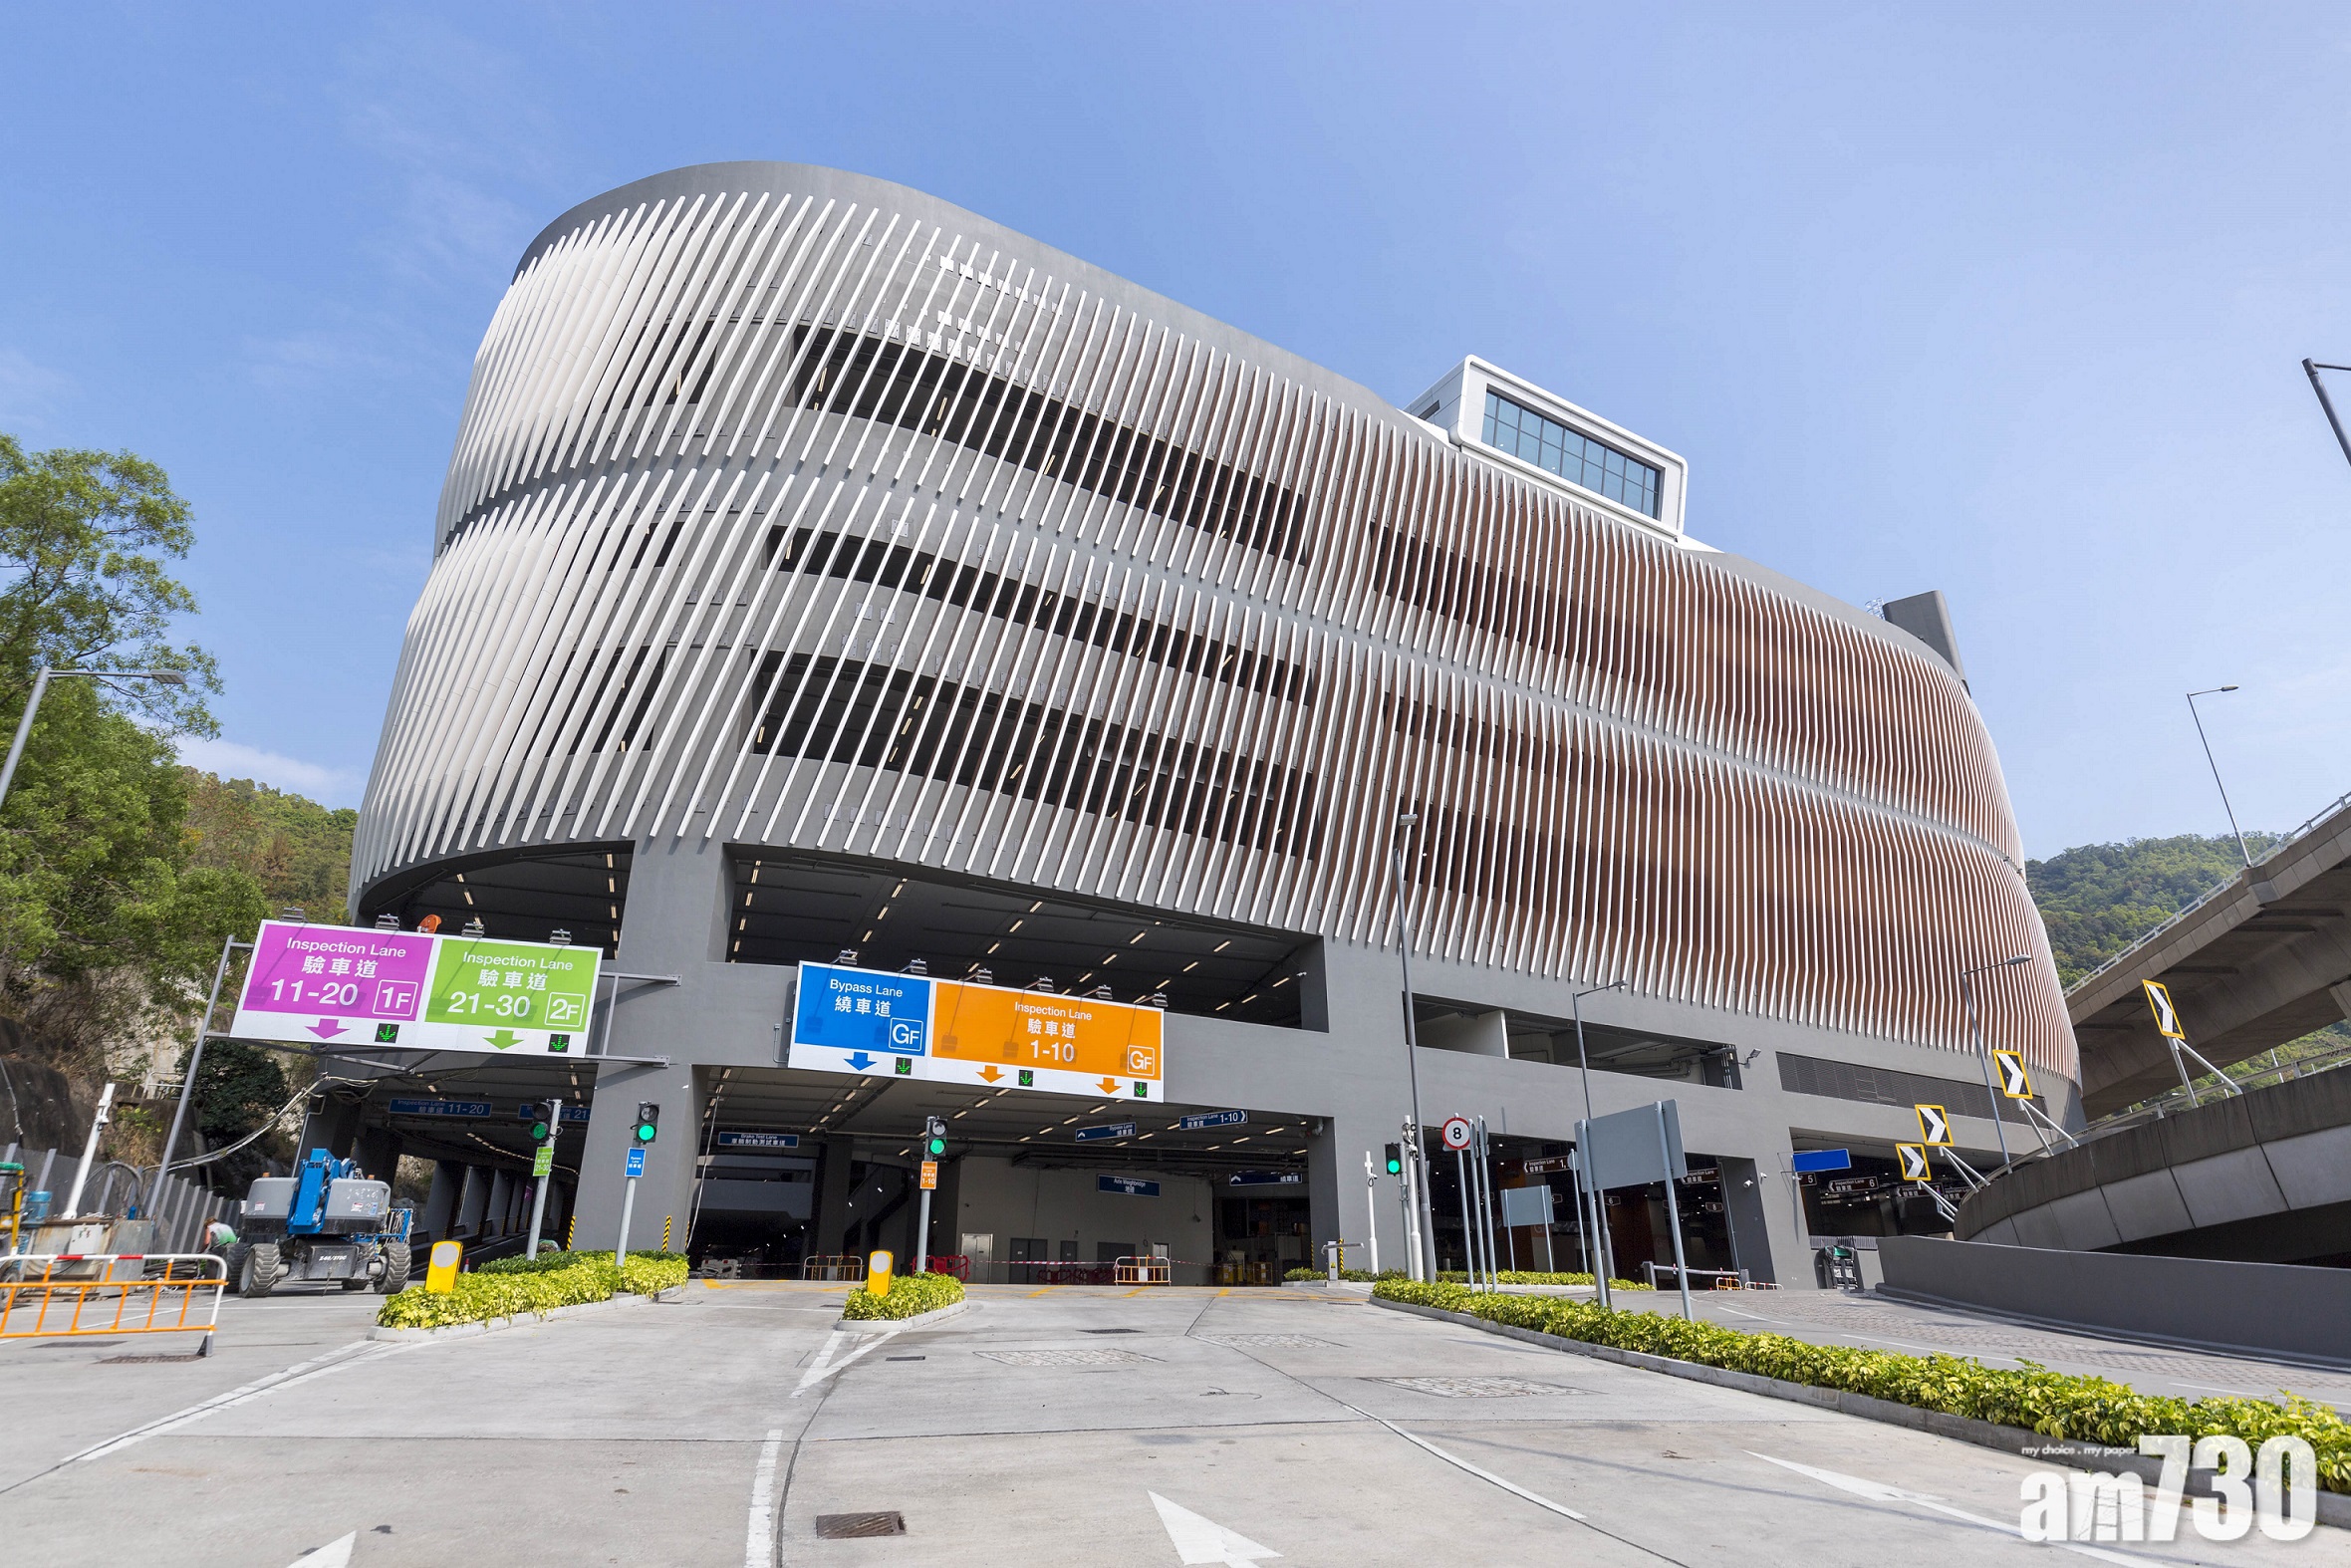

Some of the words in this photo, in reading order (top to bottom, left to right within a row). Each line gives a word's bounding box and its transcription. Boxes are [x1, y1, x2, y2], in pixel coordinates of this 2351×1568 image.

[287, 937, 366, 955] Inspection
[370, 944, 406, 958] Lane
[301, 955, 379, 978] 驗車道
[463, 951, 536, 968] Inspection
[539, 958, 574, 971] Lane
[477, 969, 548, 991] 驗車道
[830, 978, 873, 993] Bypass
[876, 984, 904, 997] Lane
[271, 978, 359, 1006] 11-20
[382, 986, 411, 1009] 1F
[447, 991, 531, 1017] 21-30
[550, 998, 580, 1020] 2F
[835, 995, 892, 1017] 繞車道
[1014, 1002, 1066, 1017] Inspection
[1068, 1009, 1093, 1021] Lane
[892, 1023, 920, 1045] GF
[1027, 1018, 1076, 1039] 驗車道
[1030, 1039, 1075, 1062] 1-10
[1129, 1050, 1153, 1070] GF
[448, 1103, 484, 1115] 11-20
[1219, 1111, 1239, 1123] 1-10
[1452, 1127, 1462, 1140] 8
[1807, 1175, 1814, 1183] 5
[1869, 1178, 1876, 1187] 6
